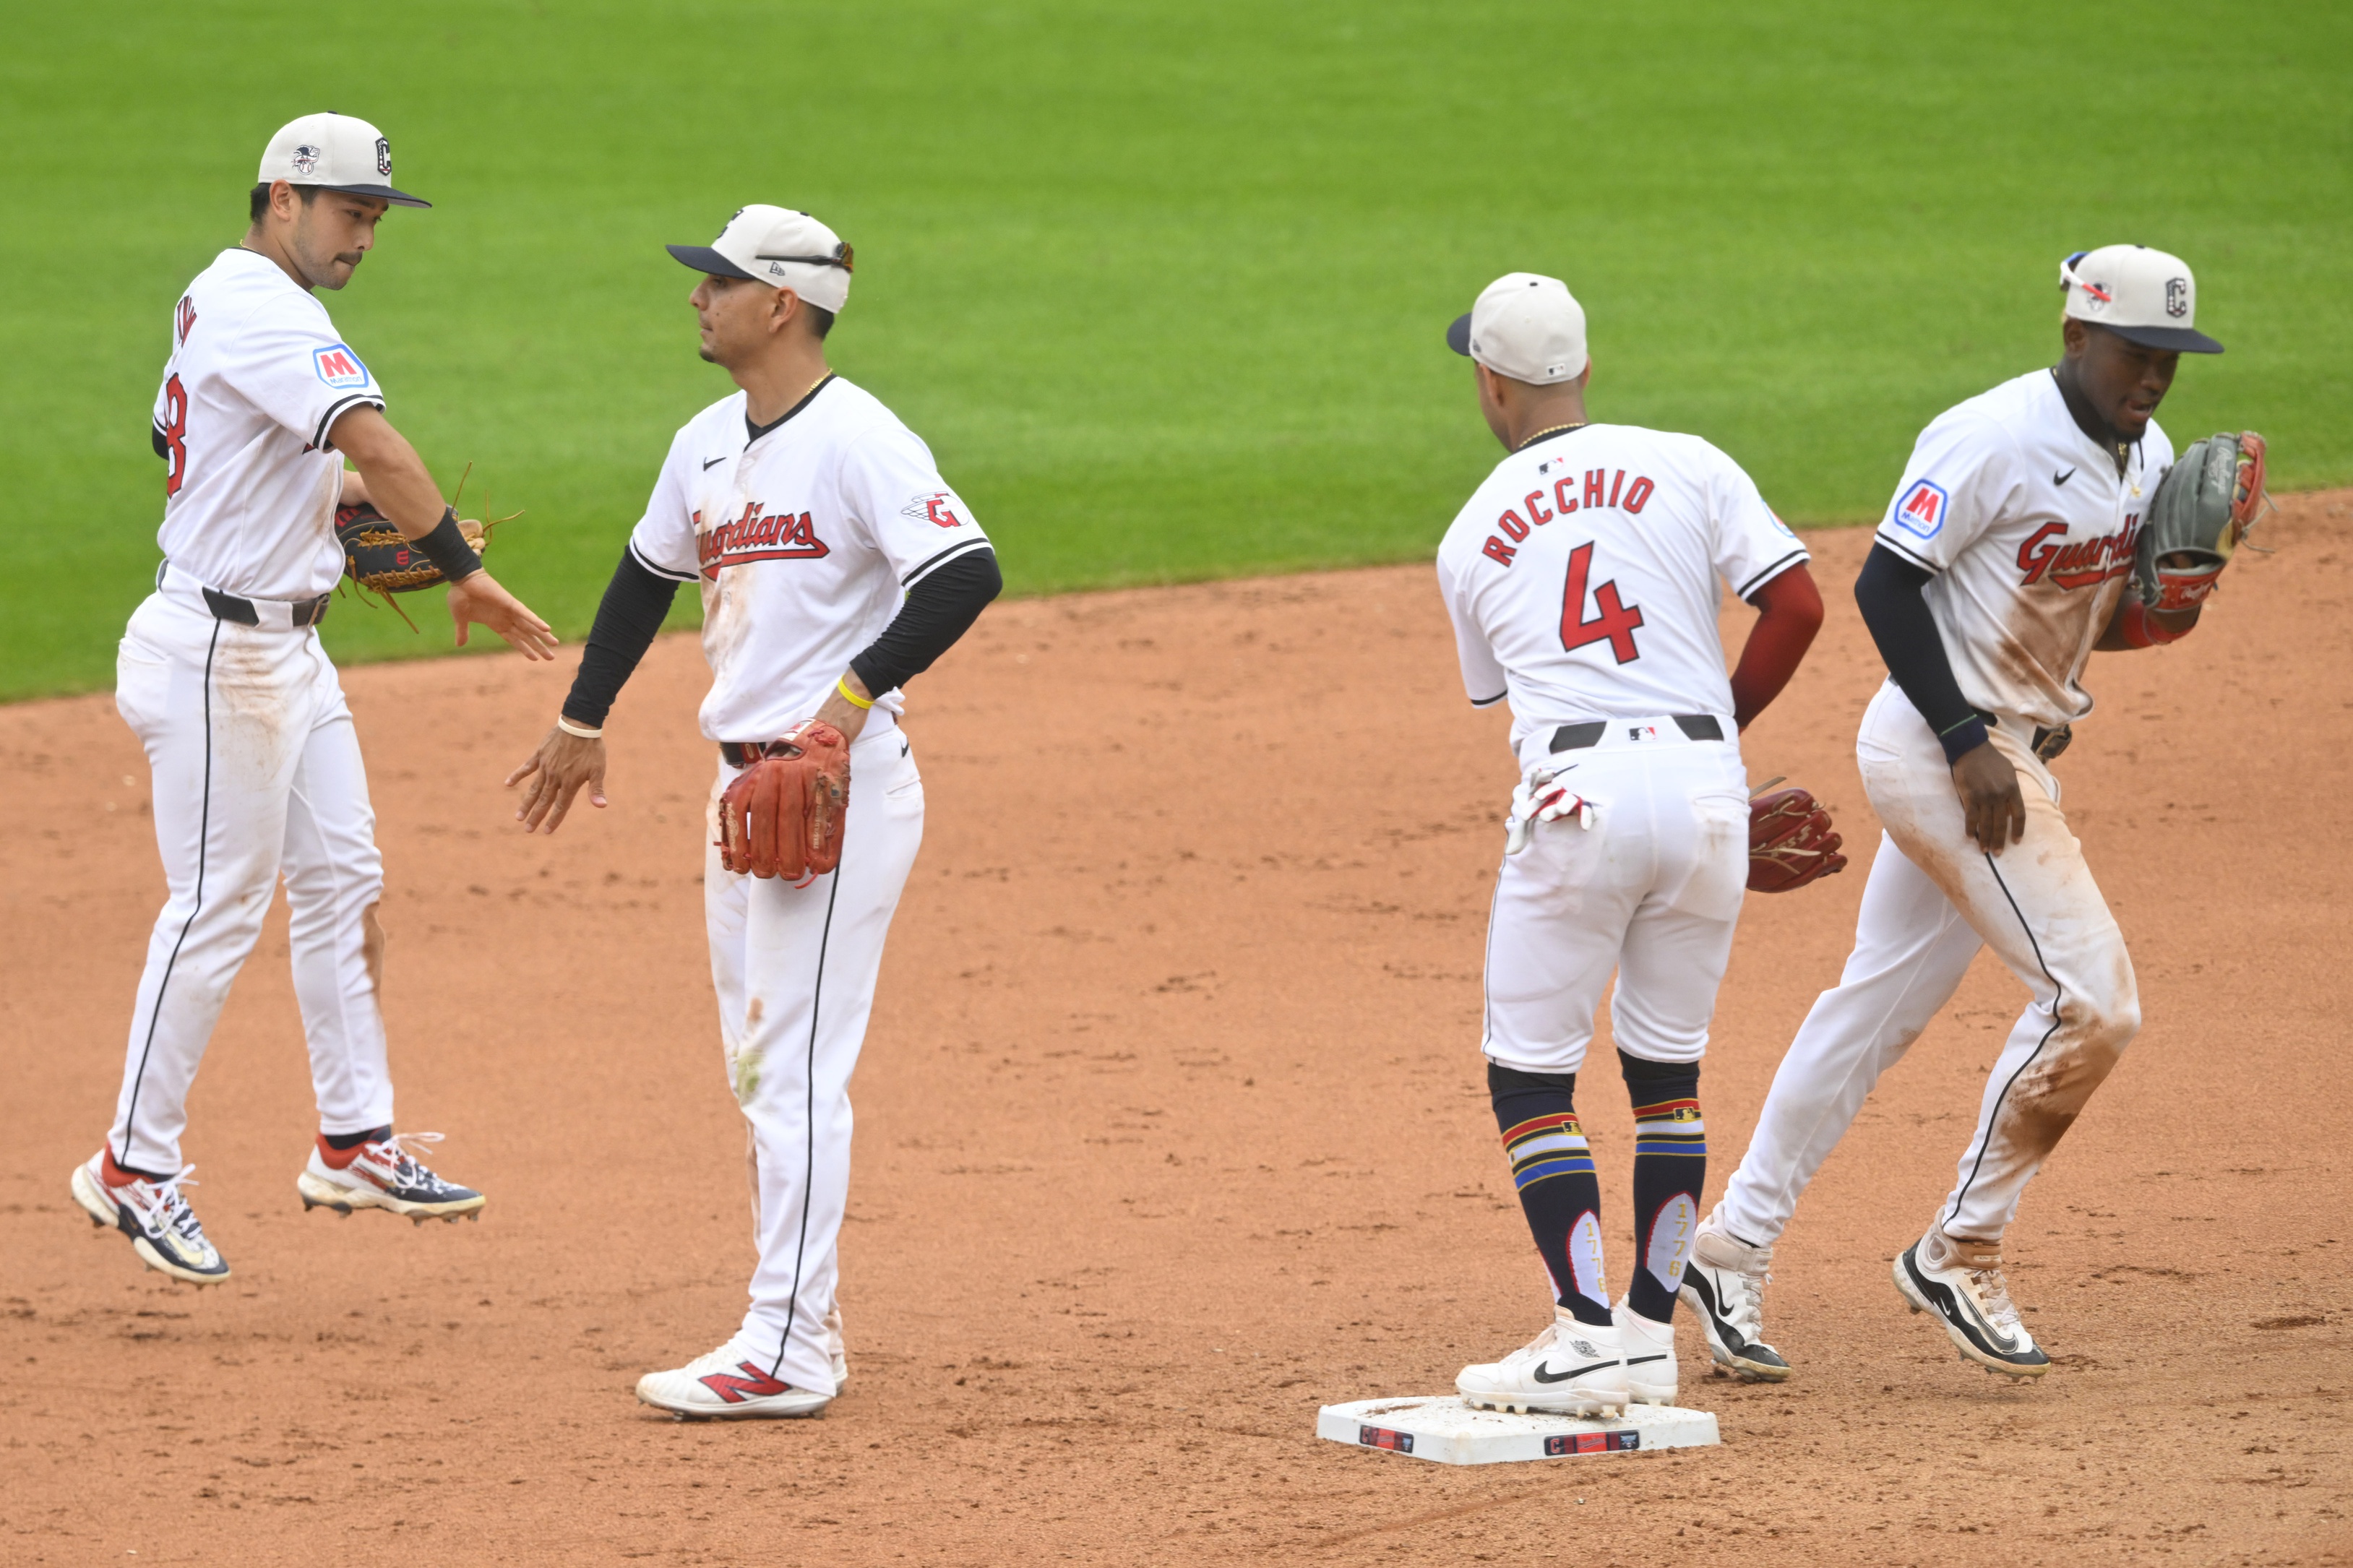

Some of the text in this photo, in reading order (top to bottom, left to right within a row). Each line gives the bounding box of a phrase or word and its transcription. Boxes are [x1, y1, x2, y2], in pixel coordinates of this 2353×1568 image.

[375, 137, 392, 176] C
[2166, 277, 2188, 318] C
[320, 351, 358, 377] M
[1482, 468, 1655, 568] ROCCHIO
[1906, 486, 1940, 524] M
[1560, 540, 1645, 665] 4
[1585, 1222, 1606, 1293] 1776
[1668, 1203, 1689, 1277] 1776
